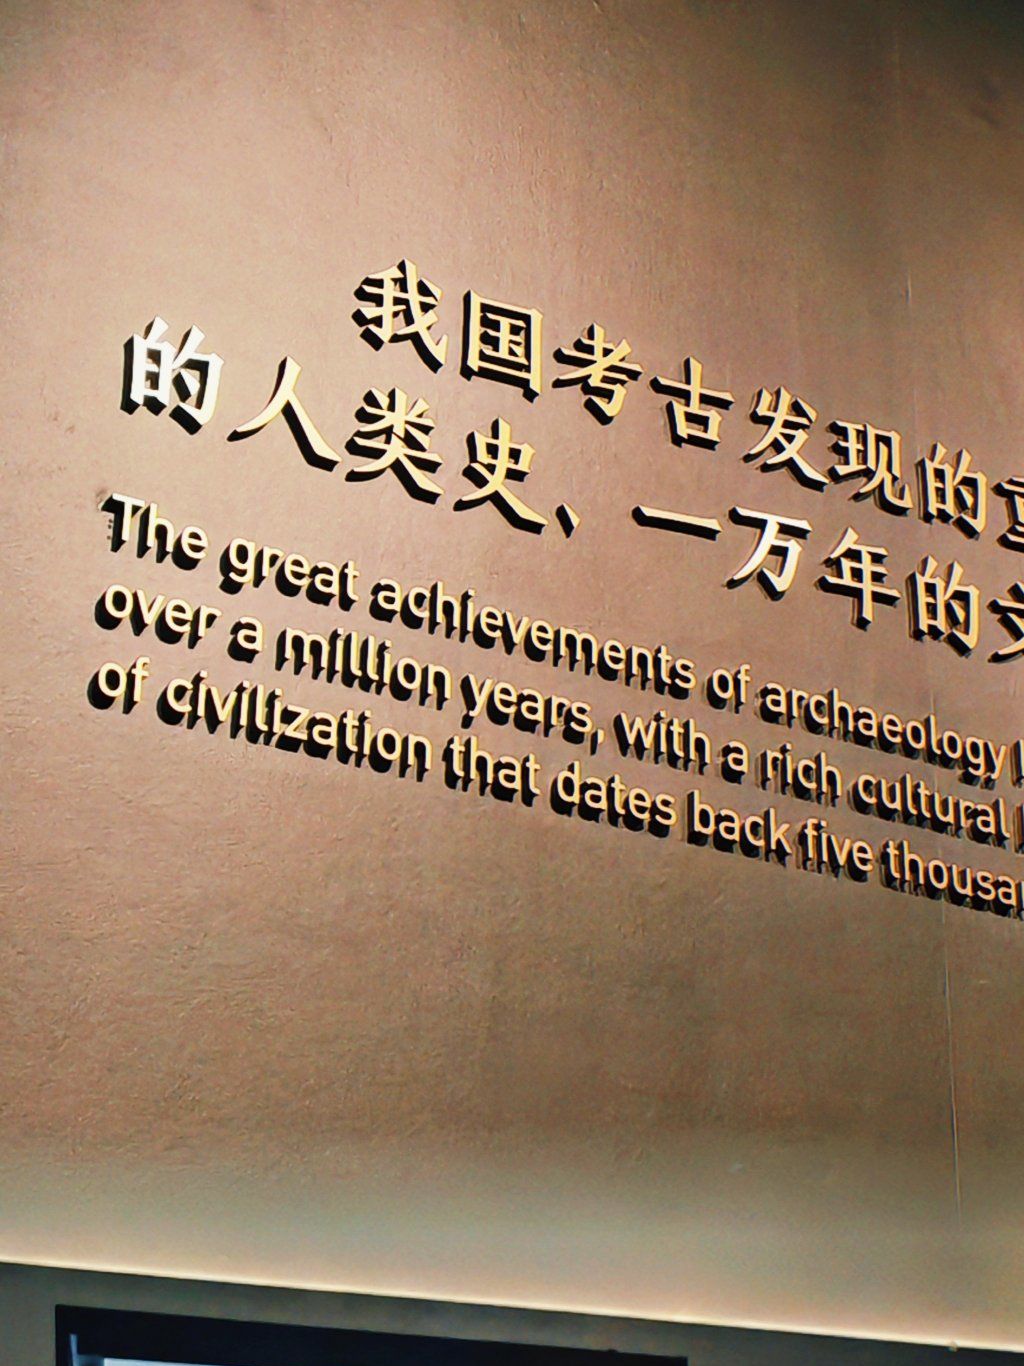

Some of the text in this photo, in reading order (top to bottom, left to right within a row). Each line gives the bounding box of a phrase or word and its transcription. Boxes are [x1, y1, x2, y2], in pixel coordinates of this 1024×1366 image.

[94, 658, 151, 706] of
[160, 670, 432, 774] civilization
[447, 735, 541, 797] that
[552, 760, 679, 836] dates
[687, 789, 793, 863] back
[799, 817, 874, 880] five
[98, 582, 222, 644] over
[230, 615, 264, 660] a
[279, 628, 453, 706] million
[460, 673, 605, 748] years,
[615, 710, 712, 770] with
[722, 740, 750, 780] a
[760, 743, 843, 802] rich
[850, 772, 1010, 847] cultural
[103, 492, 208, 560] The
[223, 535, 360, 606] great
[372, 577, 696, 698] achievements
[709, 664, 752, 706] of
[763, 681, 1007, 786] archaeology
